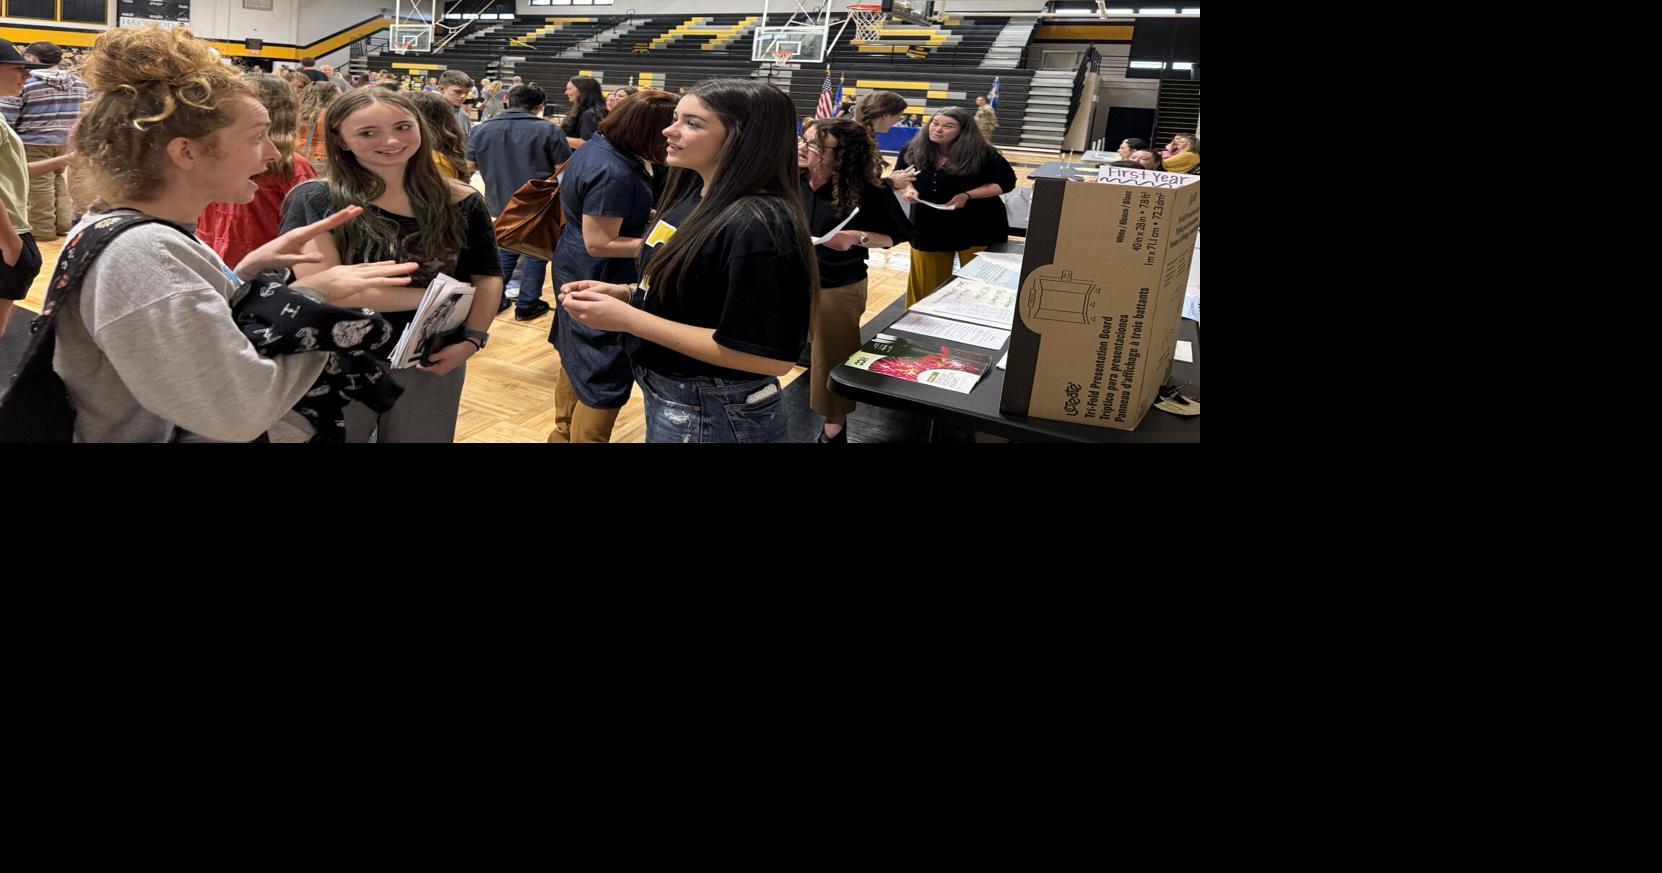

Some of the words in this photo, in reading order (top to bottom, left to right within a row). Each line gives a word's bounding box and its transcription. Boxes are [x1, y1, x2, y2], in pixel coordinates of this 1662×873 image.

[1108, 167, 1148, 180] First
[1152, 172, 1189, 185] Year
[1116, 229, 1126, 243] White
[1122, 190, 1132, 205] Blanc
[1132, 287, 1150, 319] battants
[1099, 316, 1113, 339] Board
[1111, 314, 1129, 372] presentaciones
[1132, 320, 1143, 339] trois
[1090, 341, 1108, 389] Presentation
[1122, 347, 1141, 389] d'affichage
[1108, 373, 1119, 391] para
[1085, 390, 1100, 418] Tri-Fold
[1114, 391, 1130, 422] Panneau
